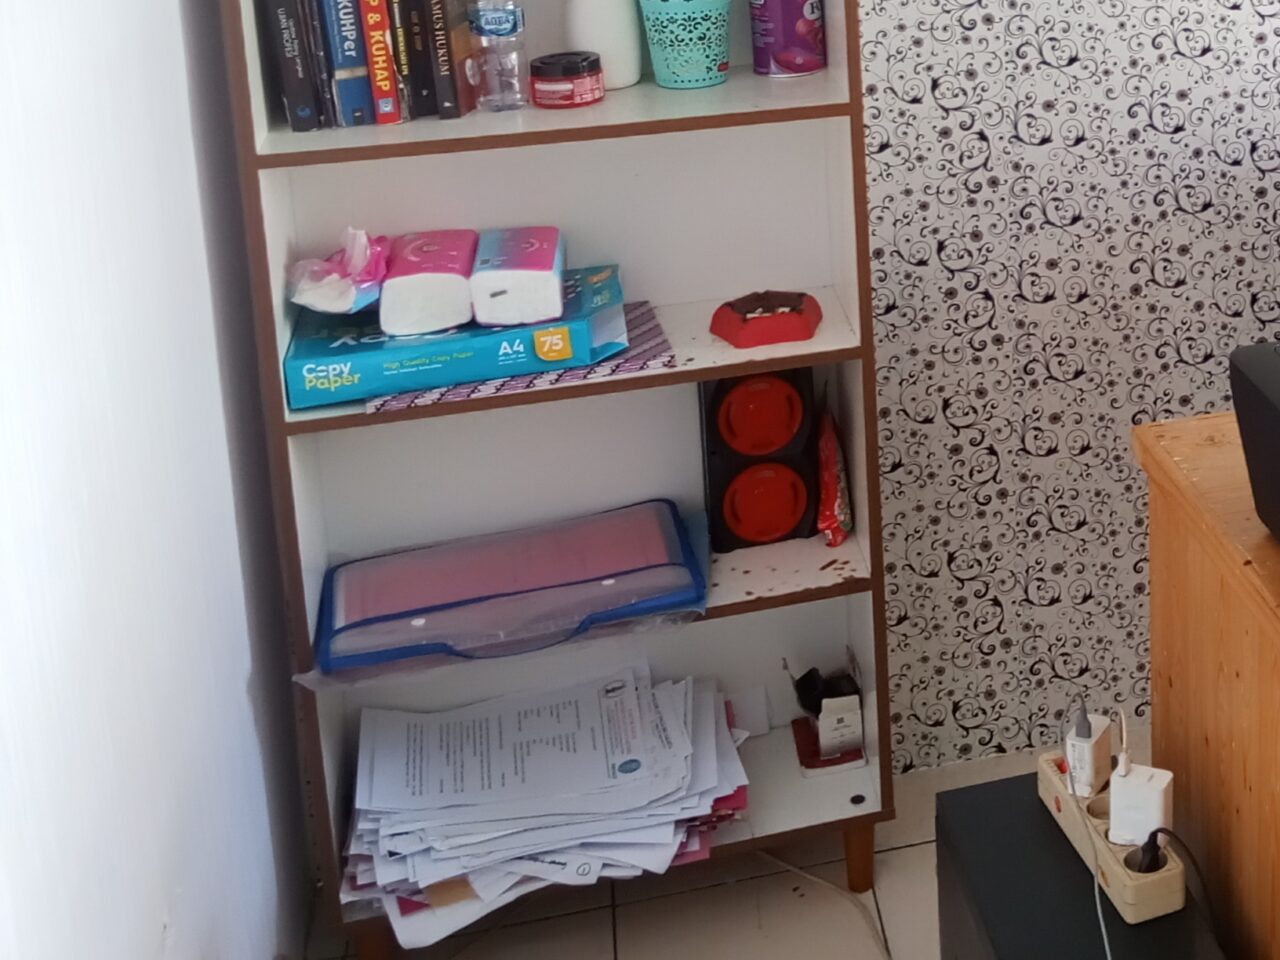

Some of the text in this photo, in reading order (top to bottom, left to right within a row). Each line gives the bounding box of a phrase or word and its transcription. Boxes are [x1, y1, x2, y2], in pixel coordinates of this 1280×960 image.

[367, 13, 381, 25] &
[369, 30, 390, 91] KUHAP
[435, 30, 450, 76] HUKUM
[498, 339, 525, 355] A4
[540, 335, 563, 352] 75
[302, 361, 351, 381] Copy
[305, 372, 361, 391] Paper
